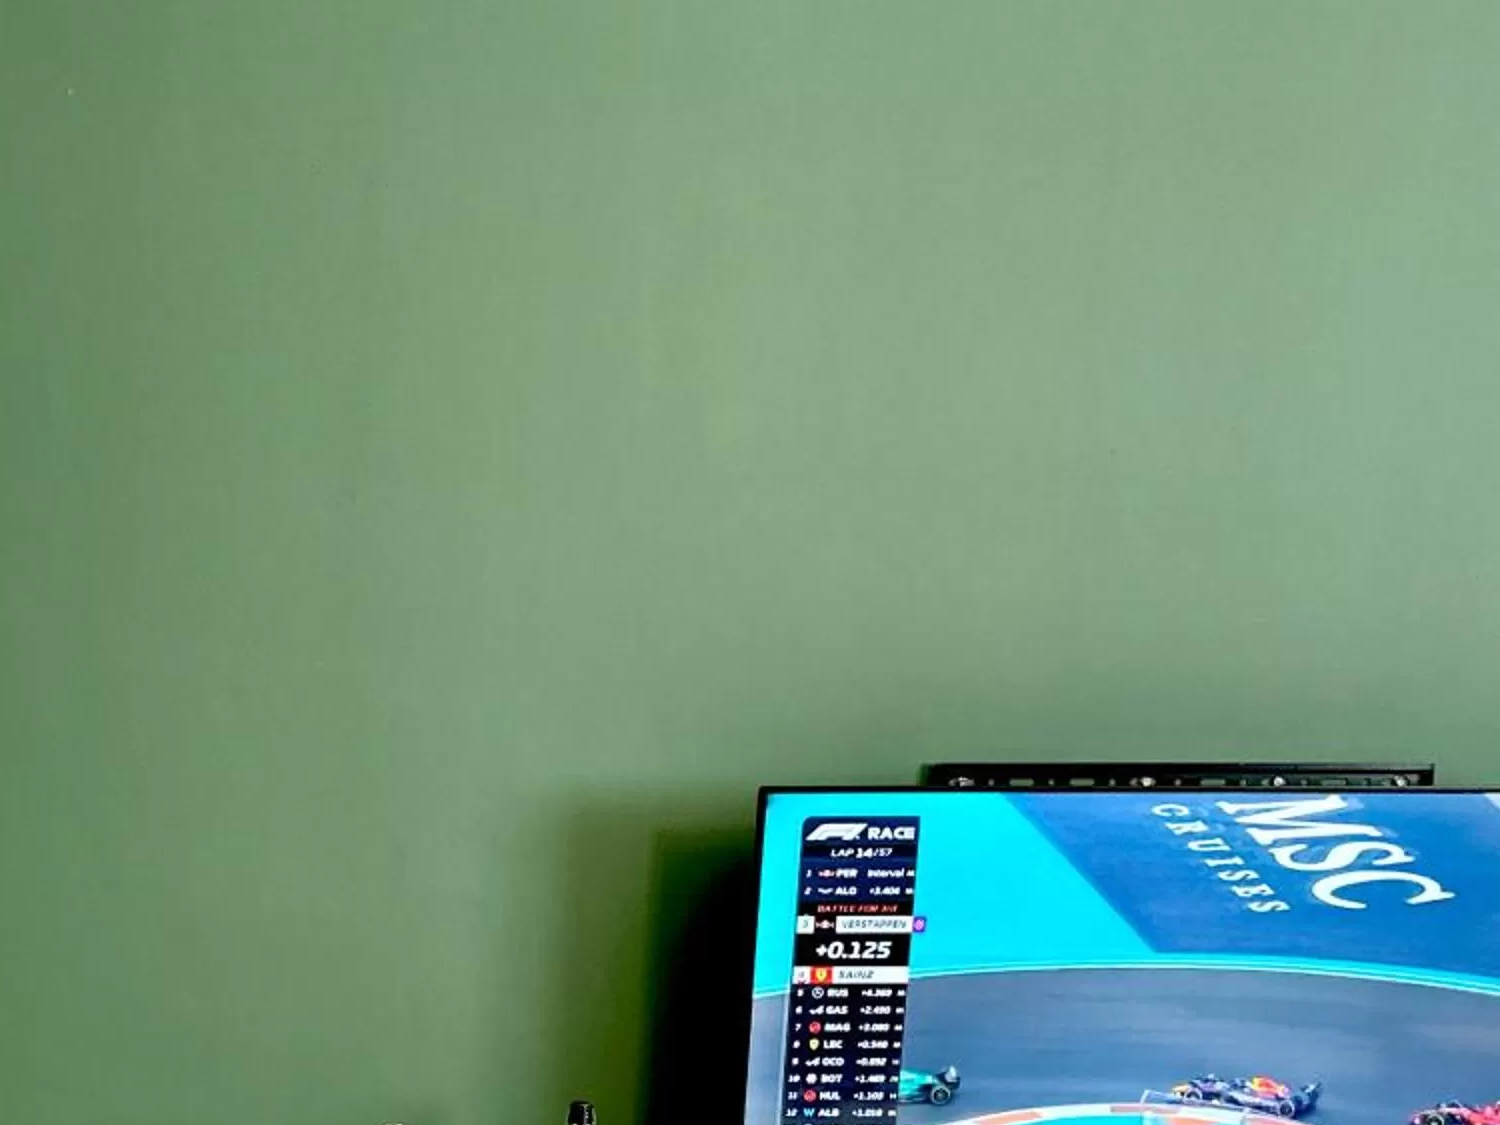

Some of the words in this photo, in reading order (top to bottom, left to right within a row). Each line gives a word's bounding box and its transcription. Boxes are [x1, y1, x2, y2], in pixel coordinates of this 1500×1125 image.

[867, 827, 916, 840] RACE
[830, 848, 855, 857] LAP
[1151, 803, 1291, 913] CRUISES
[1215, 794, 1456, 909] MSC
[835, 868, 858, 878] PER
[841, 919, 907, 929] VERSTAPPEN
[815, 941, 892, 959] +0.125
